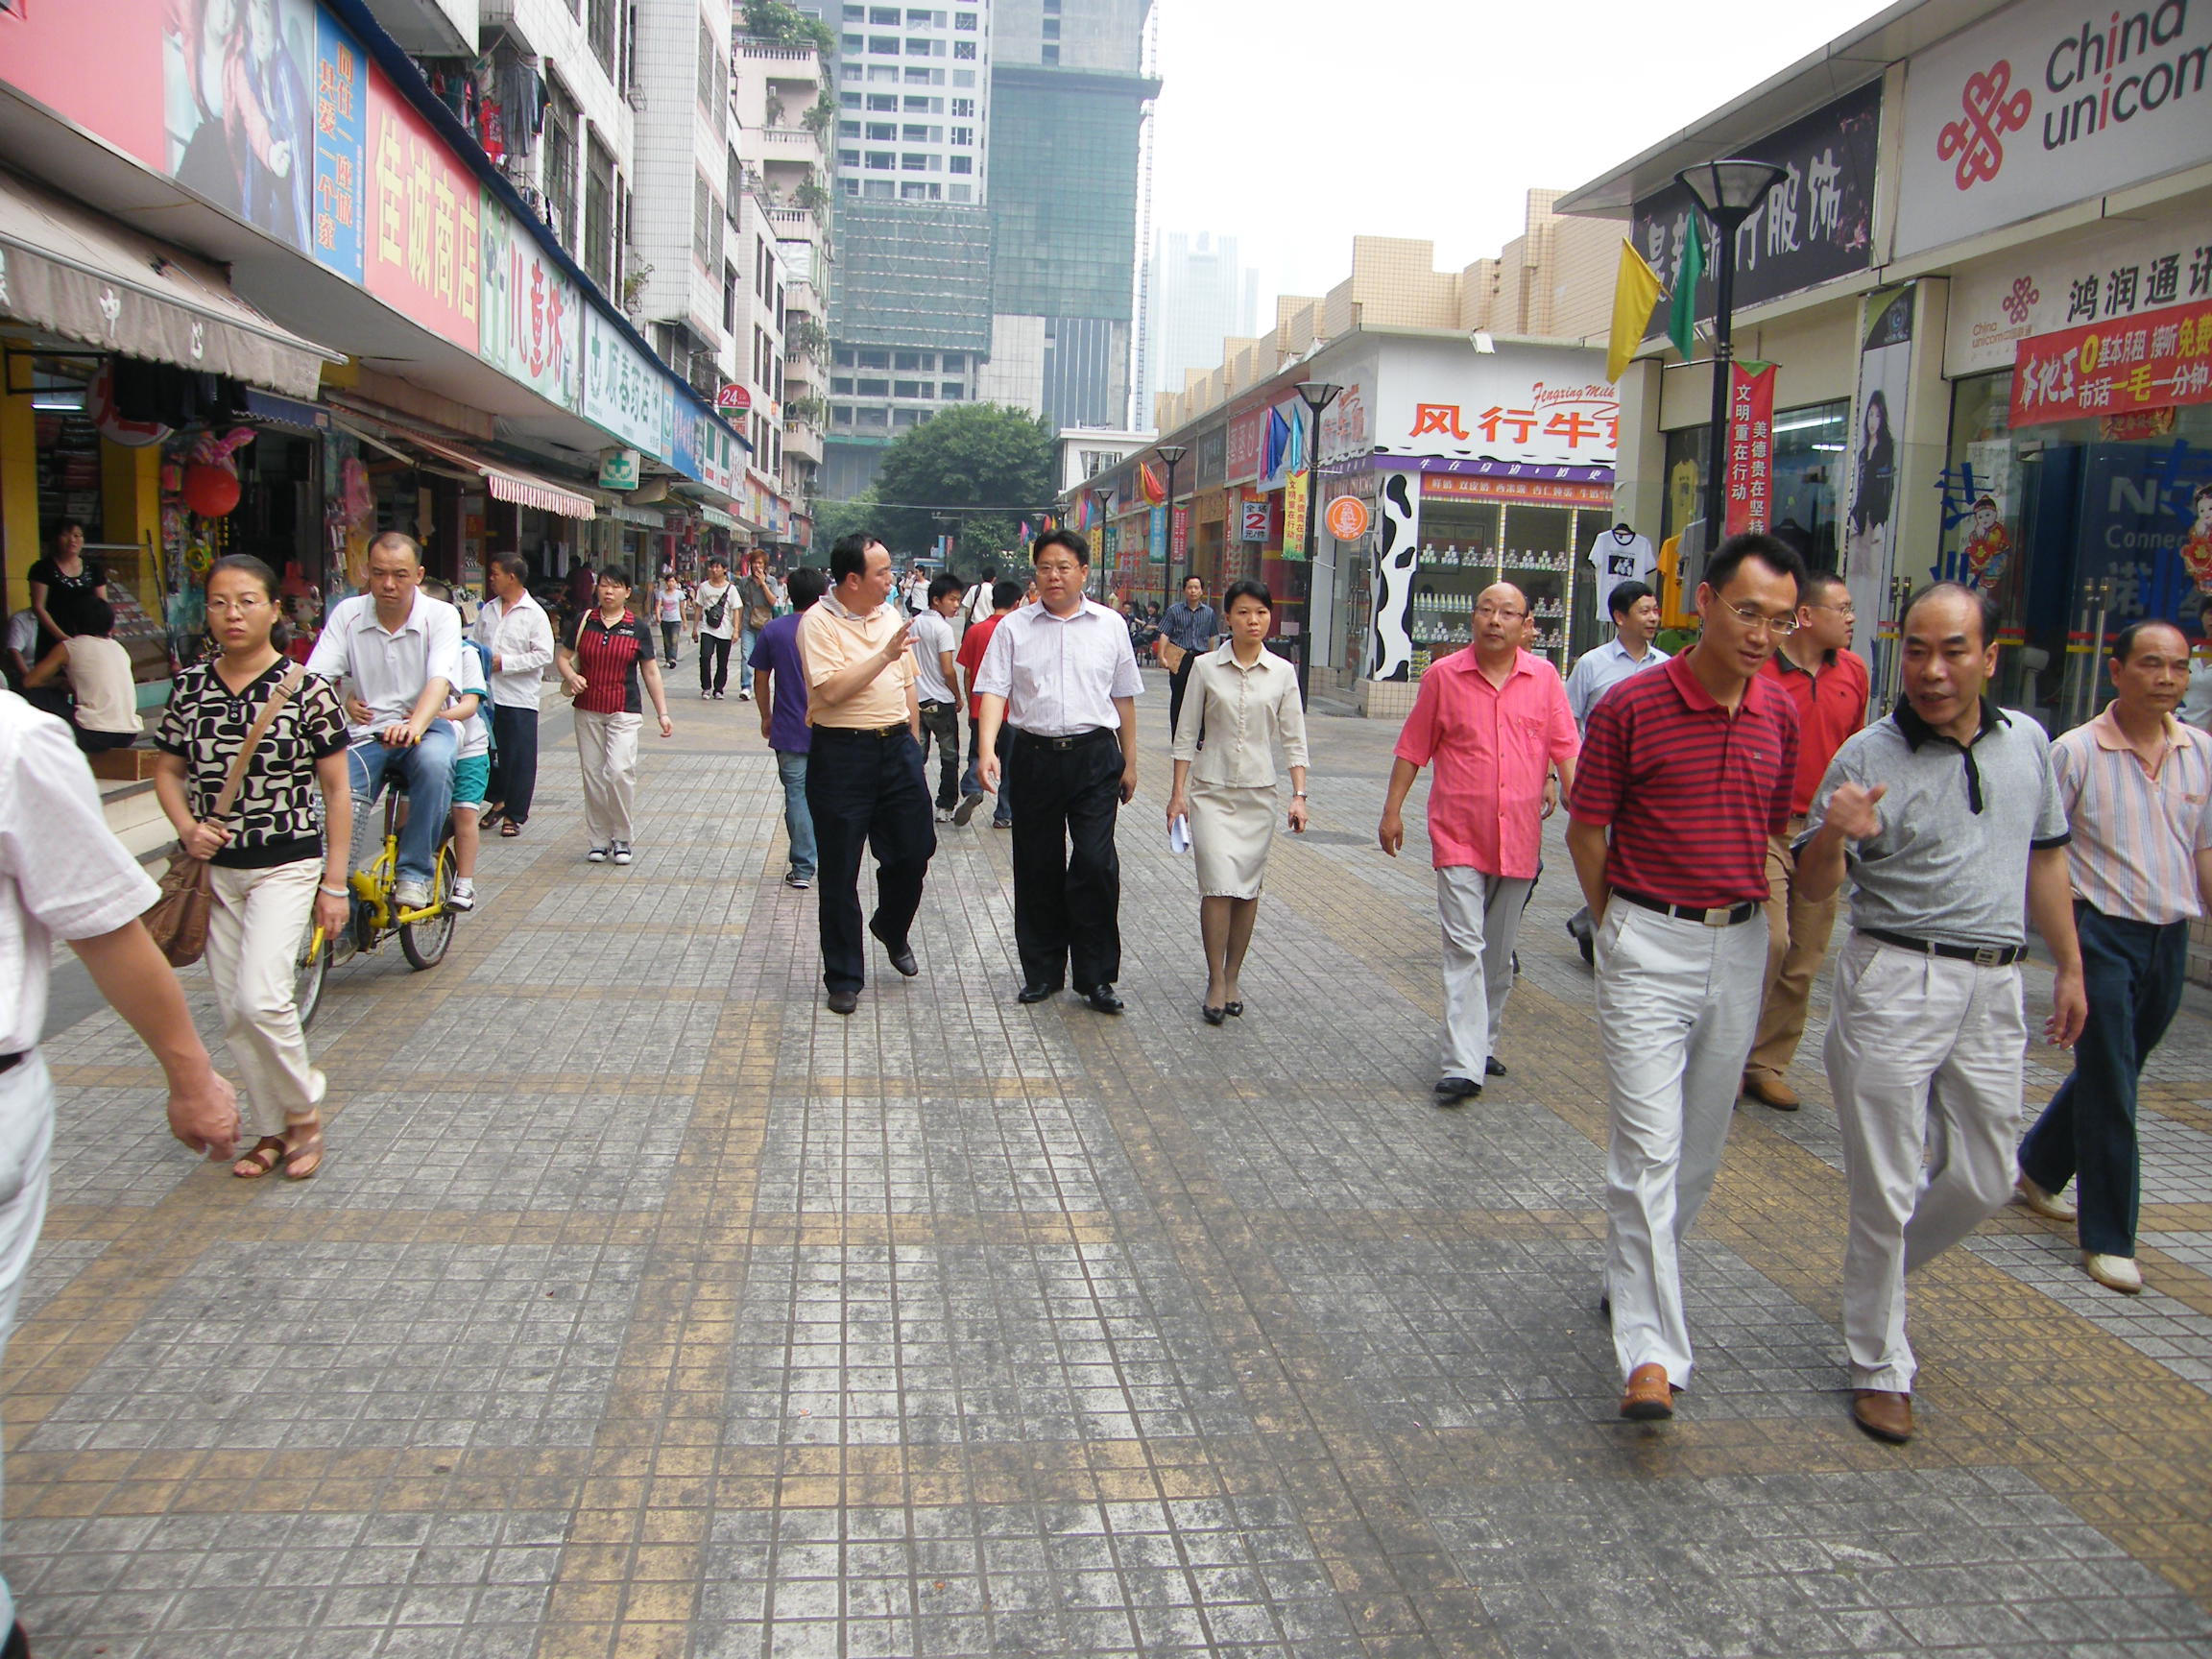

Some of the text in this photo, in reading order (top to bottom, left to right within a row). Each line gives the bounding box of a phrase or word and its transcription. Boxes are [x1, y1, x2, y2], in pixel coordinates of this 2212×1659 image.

[2046, 0, 2187, 93] China
[374, 108, 477, 324] 佳诚商店
[722, 389, 738, 406] 24
[1585, 385, 1616, 398] Milk
[1731, 384, 1752, 501] 文明重在行动
[1748, 421, 1767, 537] 美德贵在坚持
[1245, 513, 1266, 529] 2
